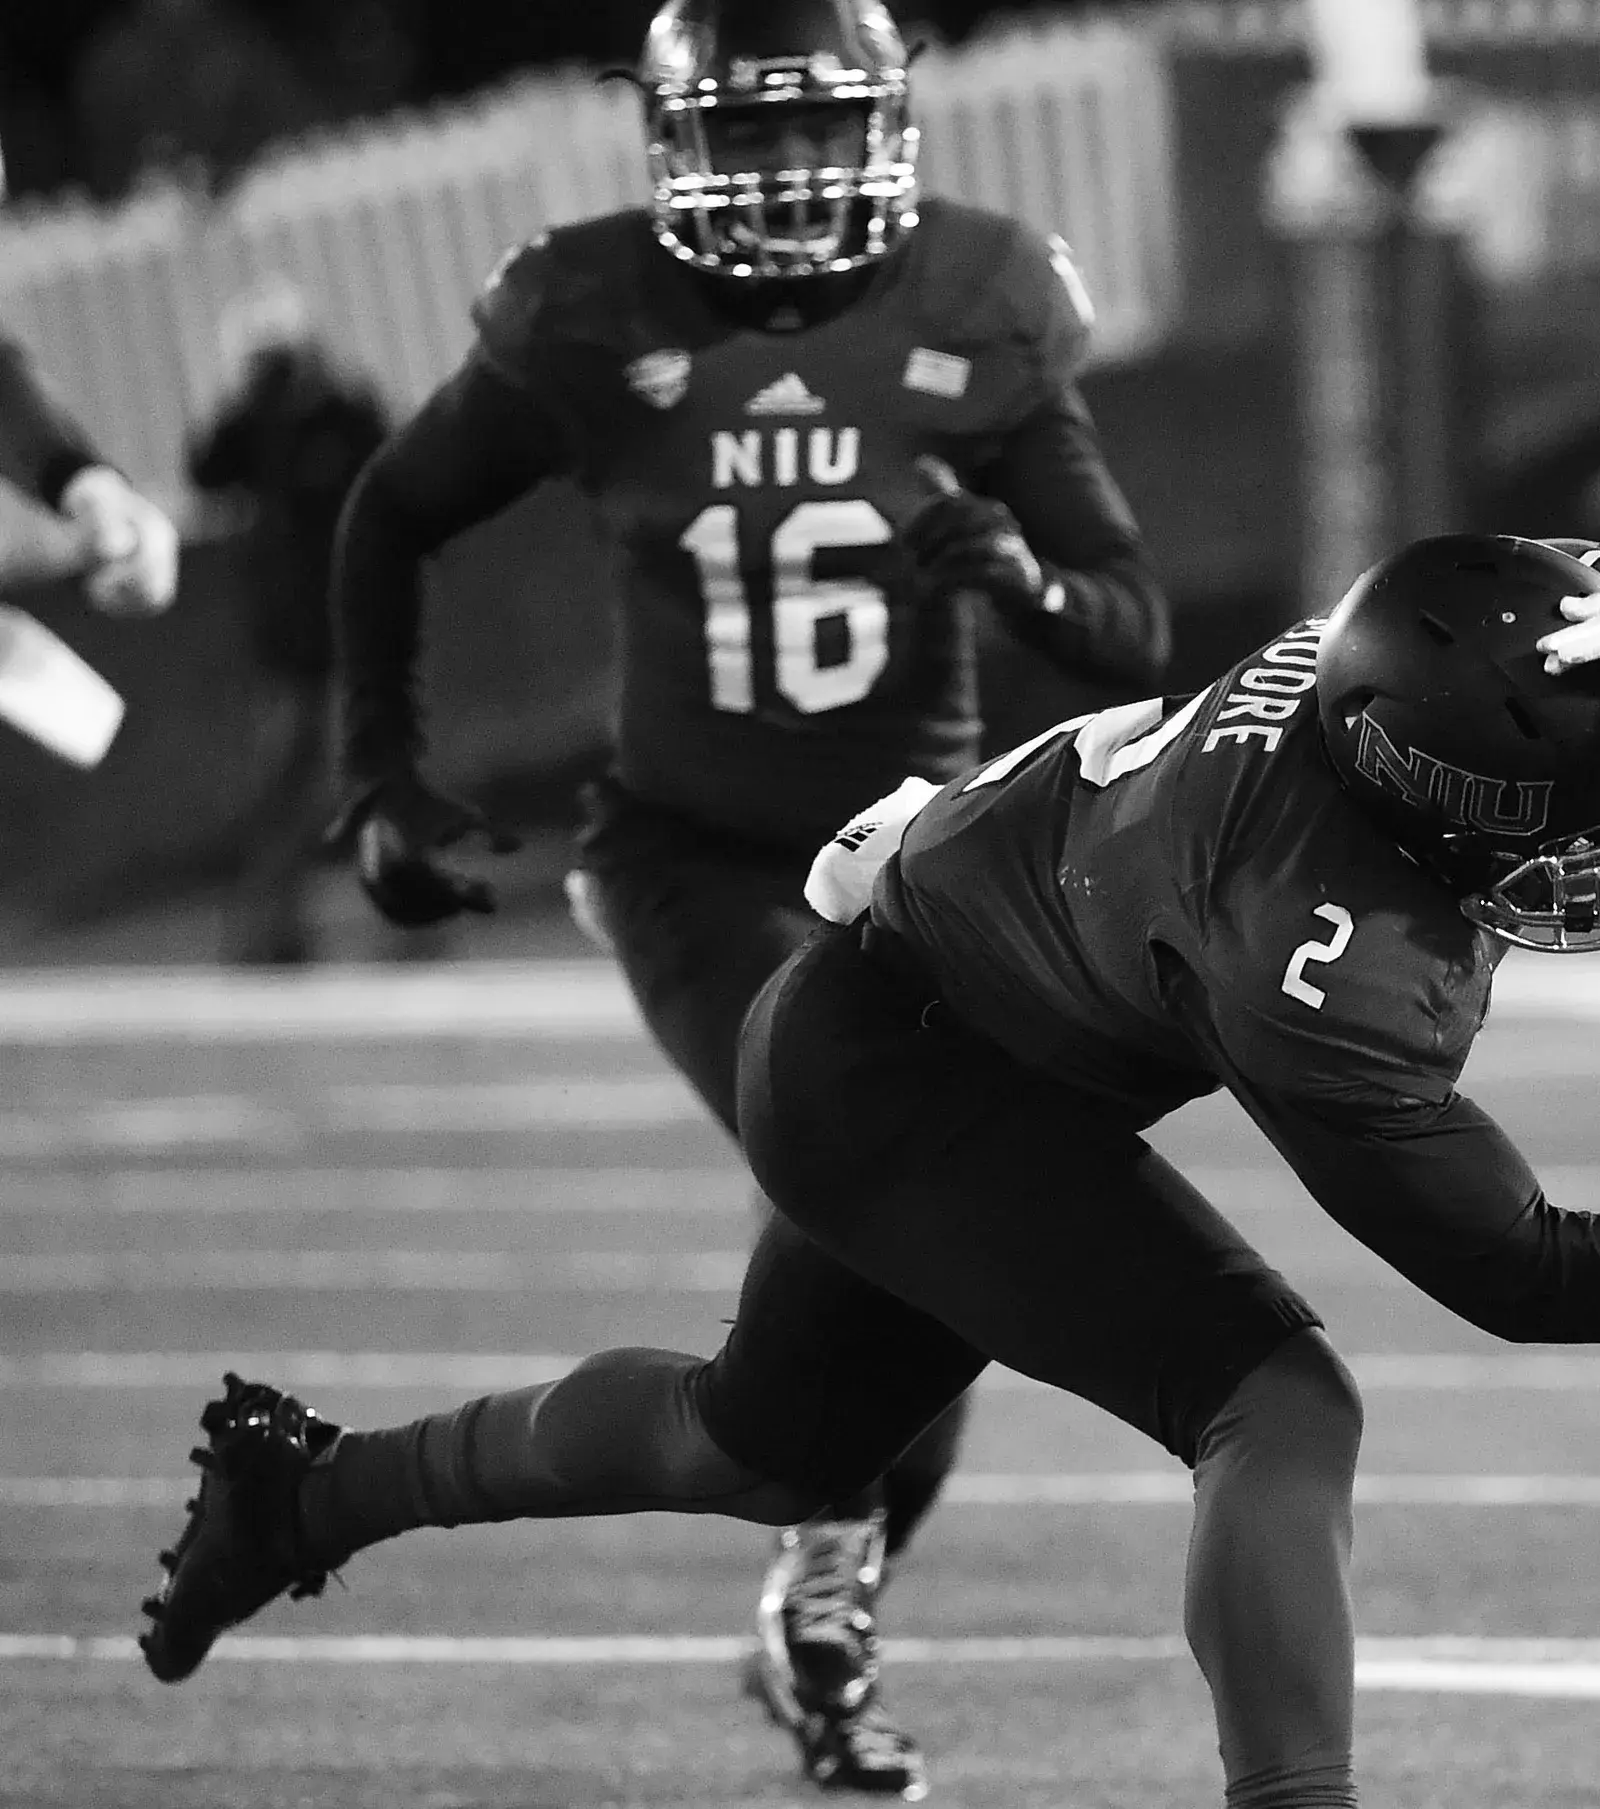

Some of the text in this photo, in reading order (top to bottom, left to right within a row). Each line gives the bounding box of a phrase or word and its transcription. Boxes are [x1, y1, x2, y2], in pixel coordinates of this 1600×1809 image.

[711, 426, 860, 488] NIU
[680, 500, 893, 713] 16
[1355, 710, 1556, 836] NIU
[1281, 902, 1354, 1010] 2
